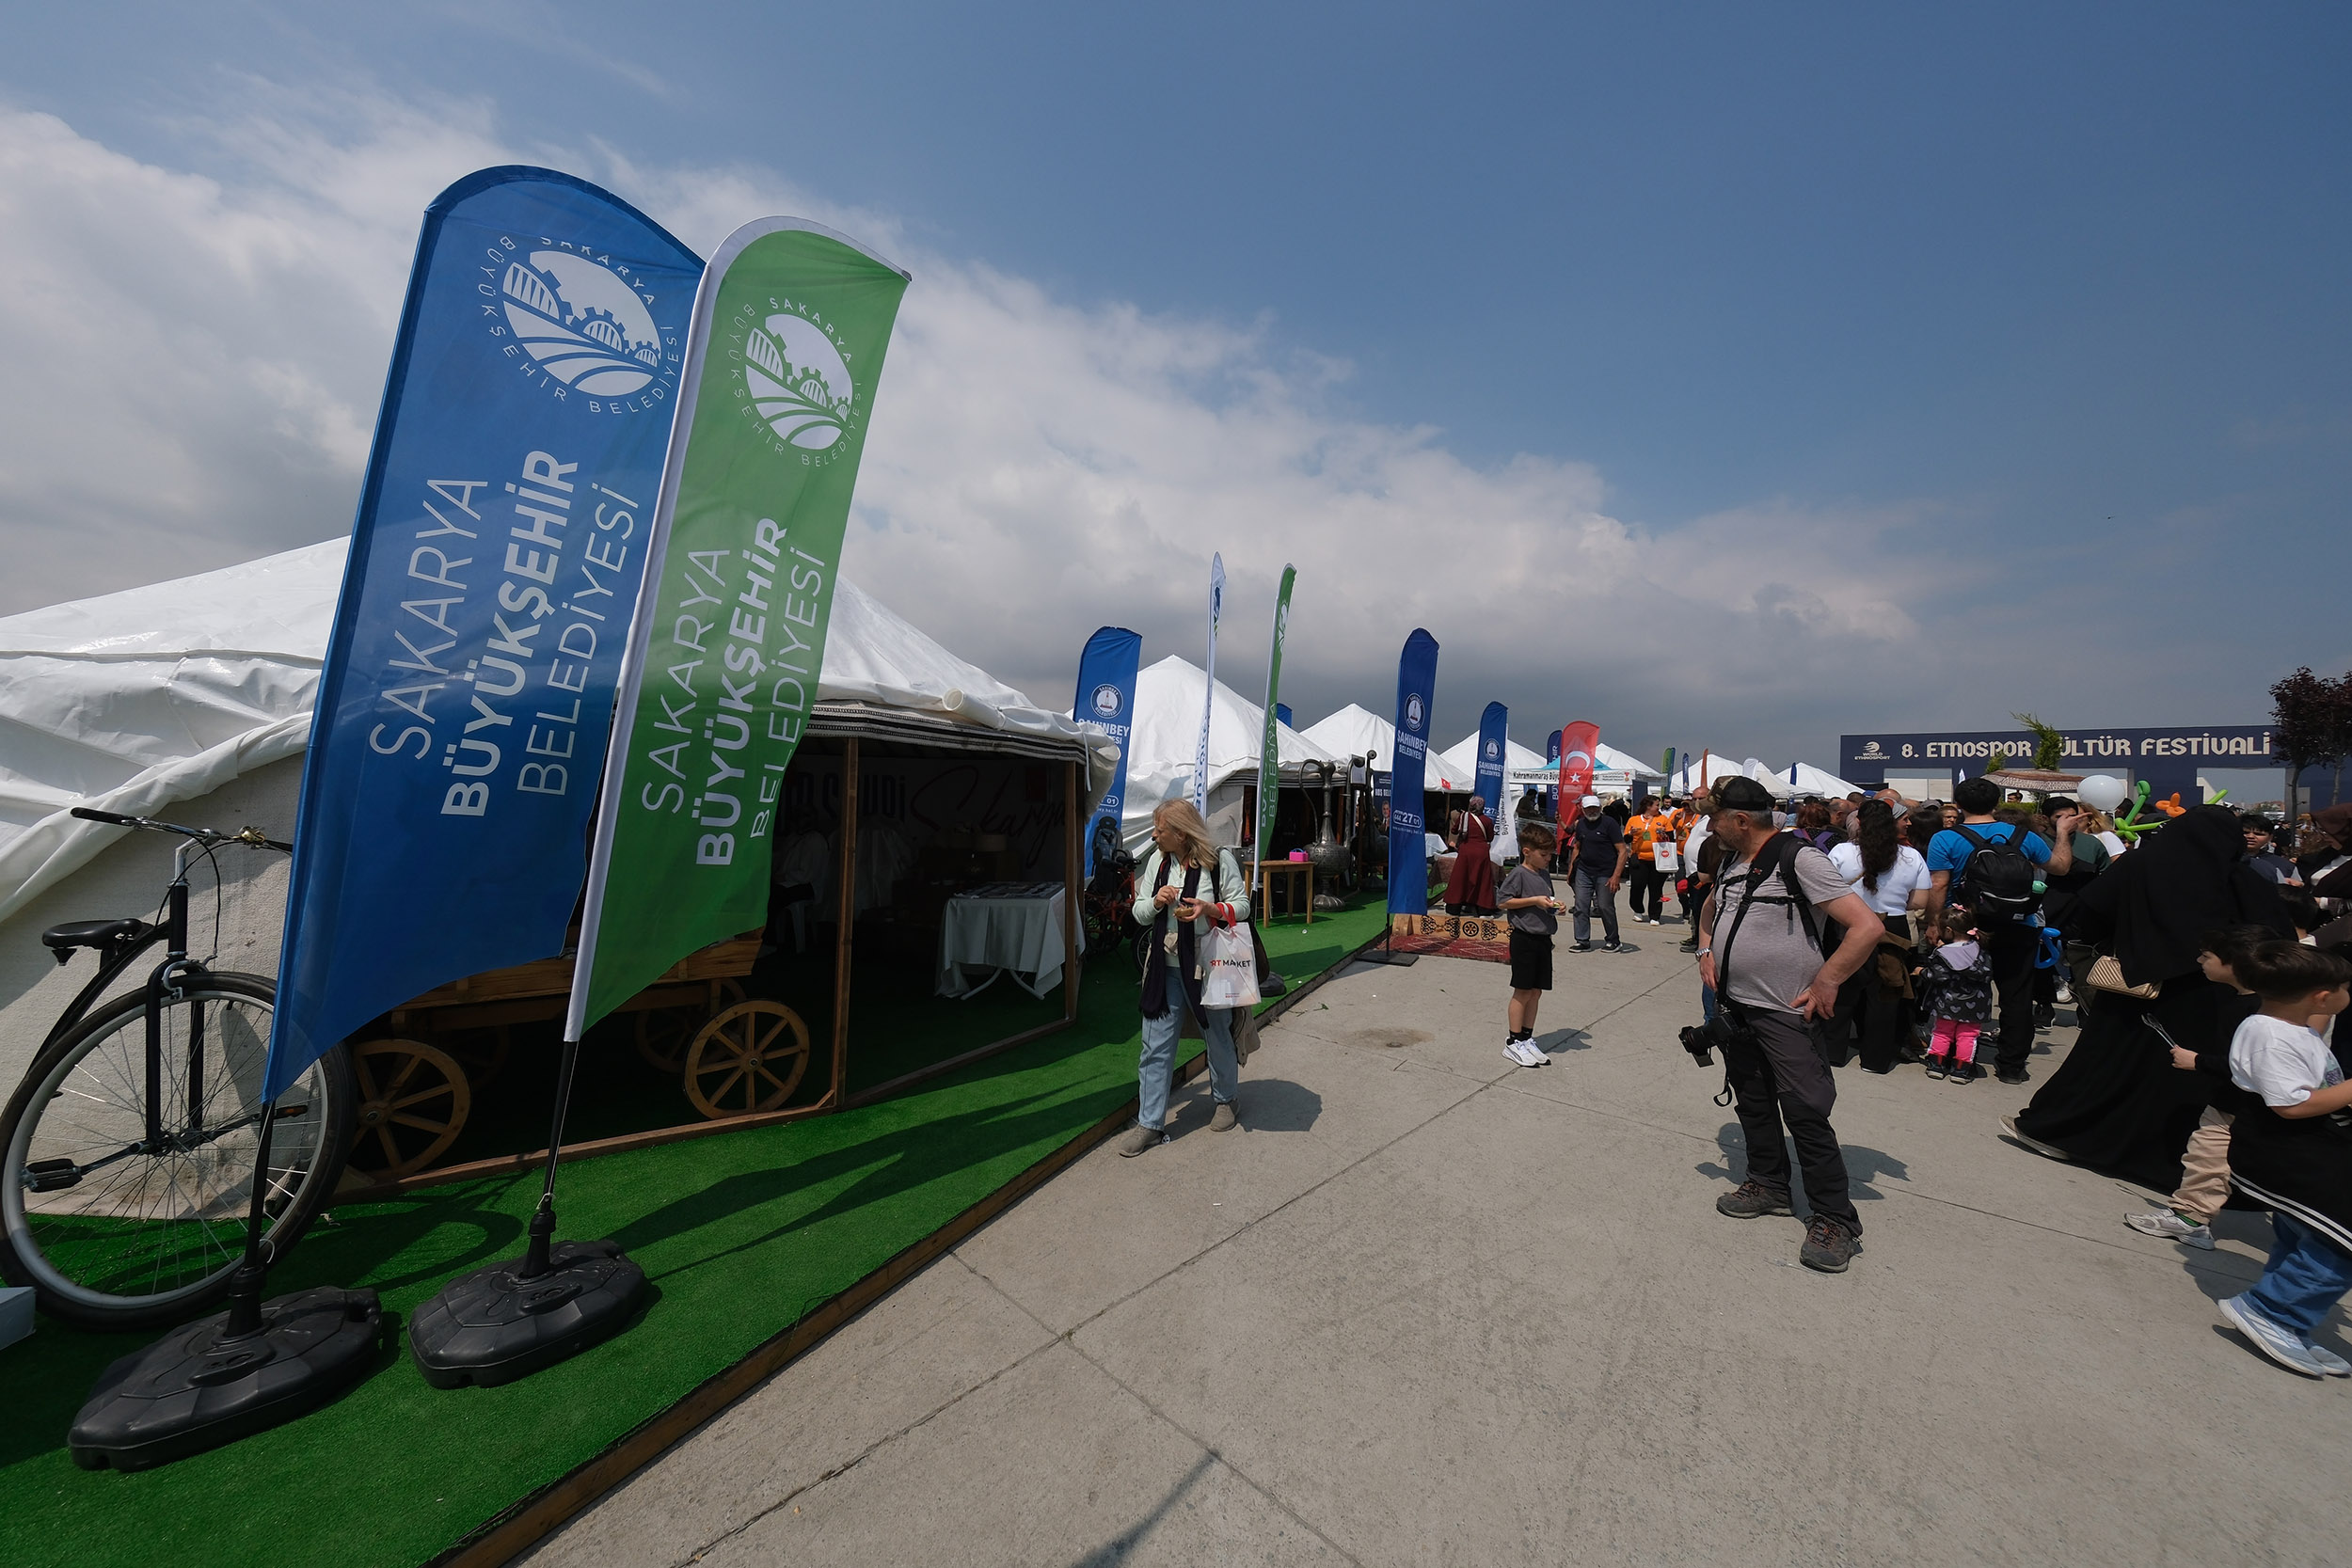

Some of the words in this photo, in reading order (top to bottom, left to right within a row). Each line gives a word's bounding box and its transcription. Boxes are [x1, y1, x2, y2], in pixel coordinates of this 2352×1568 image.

[769, 297, 852, 363] SAKARYA
[369, 479, 488, 760] SAKARYA
[440, 450, 579, 816] BÜYÜKŞEHİR
[516, 483, 640, 796] BELEDİYESİ
[642, 549, 731, 815] SAKARYA
[691, 517, 787, 866] BÜYÜKŞEHİR
[750, 545, 826, 838] BELEDİYESİ
[1901, 743, 1920, 758] 8.
[2059, 736, 2132, 757] ÜLTÜR
[2140, 731, 2270, 755] FESTİVALİ
[1402, 812, 1413, 823] 27
